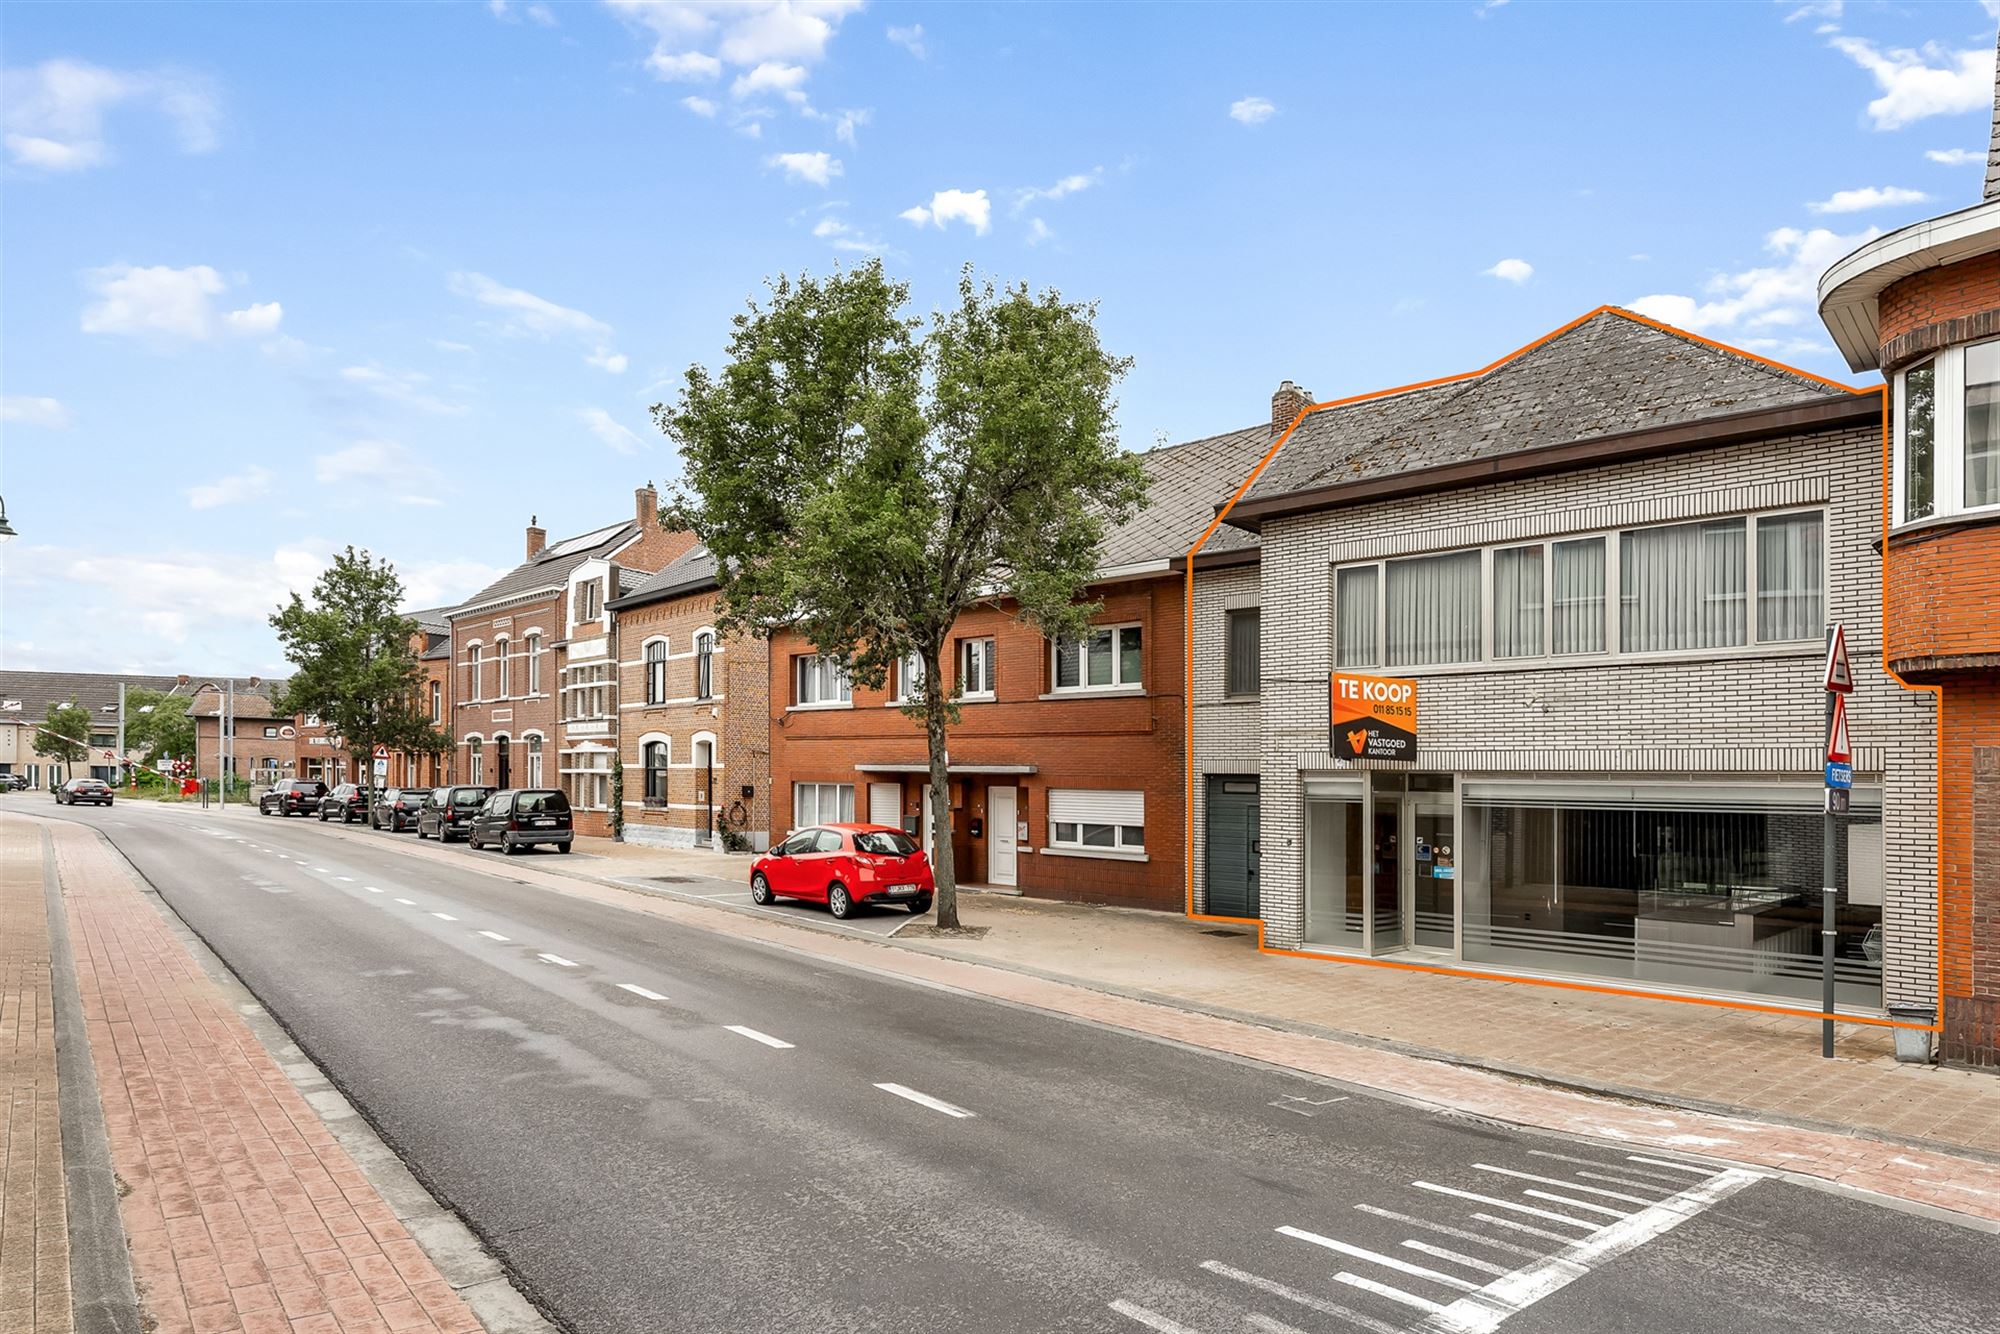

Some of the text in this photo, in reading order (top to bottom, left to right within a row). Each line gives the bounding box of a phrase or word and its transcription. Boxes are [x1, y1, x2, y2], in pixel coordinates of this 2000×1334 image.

[1338, 679, 1412, 703] TE KOOP
[1373, 704, 1412, 717] 011 85 15 15
[1368, 730, 1379, 738] HET
[1368, 738, 1406, 749] VASTGOED
[1368, 748, 1396, 756] KANTOOR
[1832, 791, 1840, 810] 90
